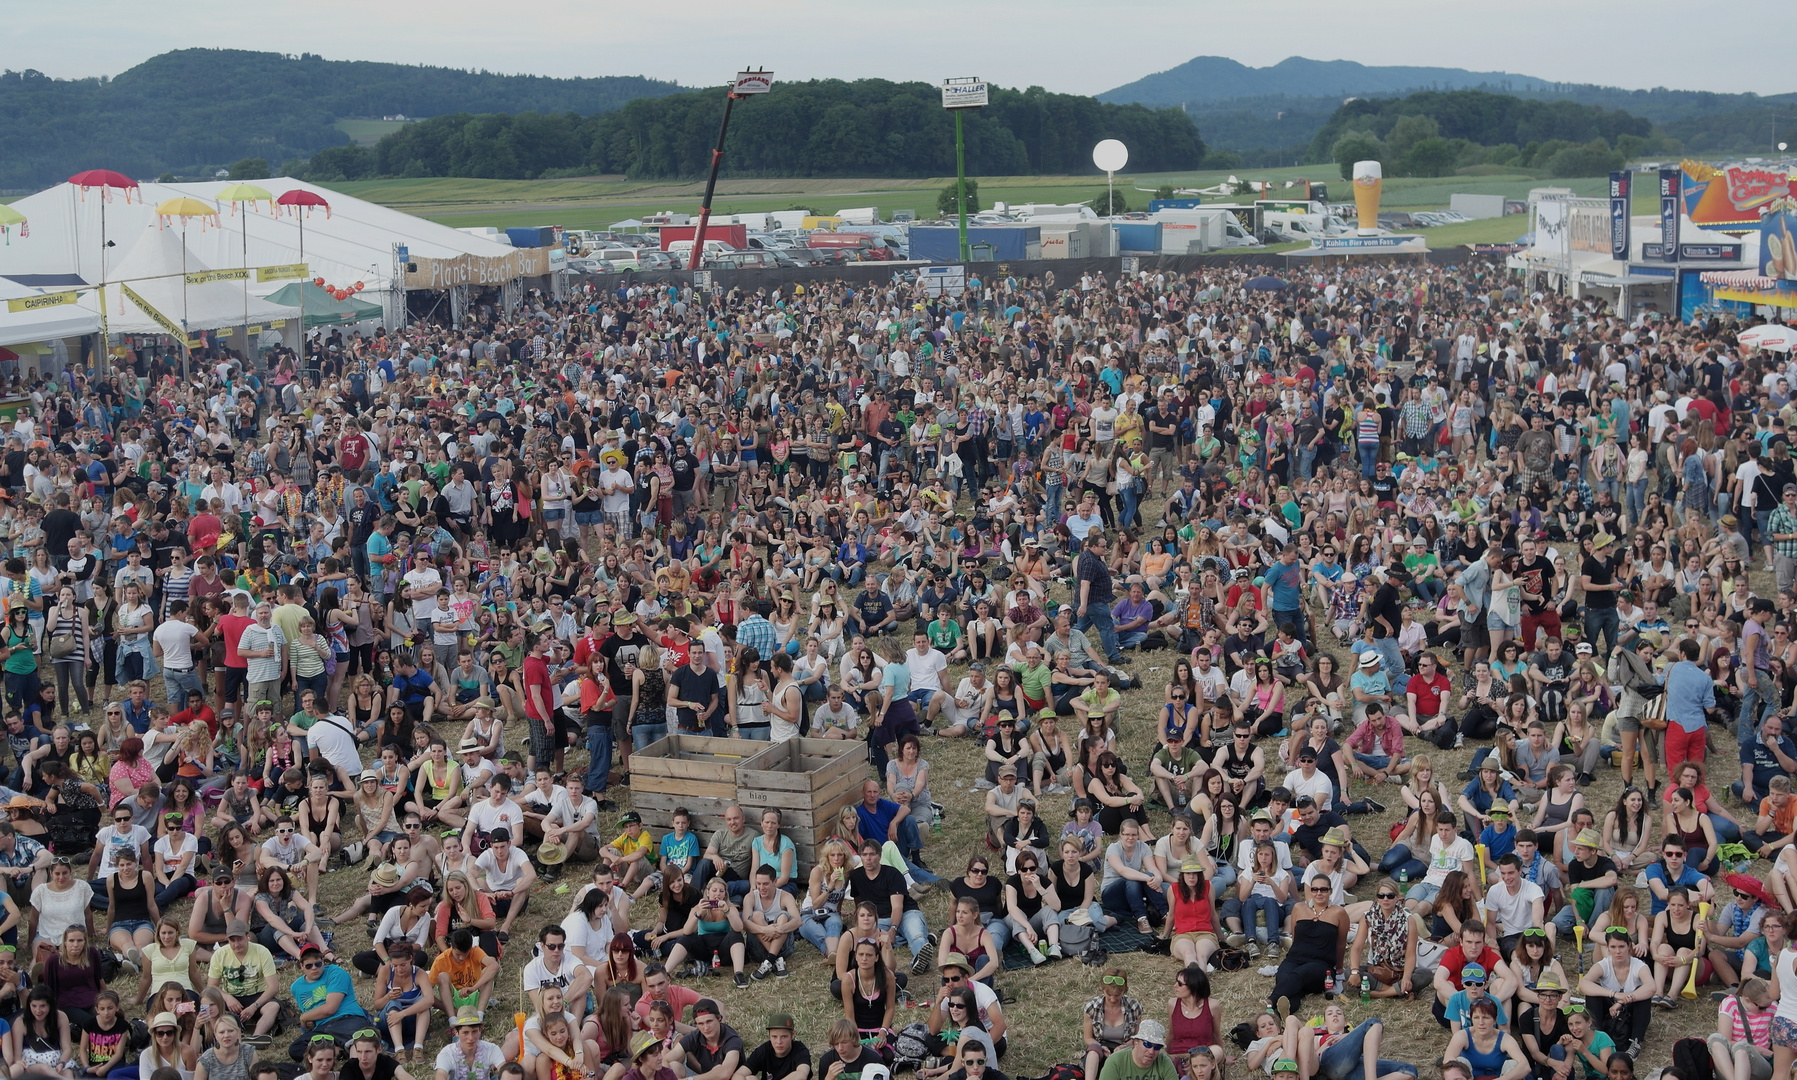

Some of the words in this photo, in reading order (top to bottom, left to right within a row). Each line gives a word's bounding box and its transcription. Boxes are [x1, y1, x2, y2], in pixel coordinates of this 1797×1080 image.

[1727, 167, 1787, 187] POMMES
[1612, 180, 1620, 197] STAY
[1661, 178, 1670, 195] STAY
[1041, 236, 1064, 248] jura
[1326, 239, 1348, 247] Kühles
[1348, 239, 1362, 247] Bier
[1379, 238, 1396, 246] Fass.
[517, 251, 538, 275] Bar
[186, 276, 199, 284] Sex
[217, 272, 234, 280] Beach
[25, 295, 63, 309] CAIPIRINHA
[124, 289, 135, 302] Sex
[135, 299, 143, 309] on
[143, 306, 153, 317] the
[153, 313, 171, 330] Beach
[170, 328, 185, 342] XXXL
[749, 792, 768, 802] hiag
[89, 1032, 122, 1047] HAPPY
